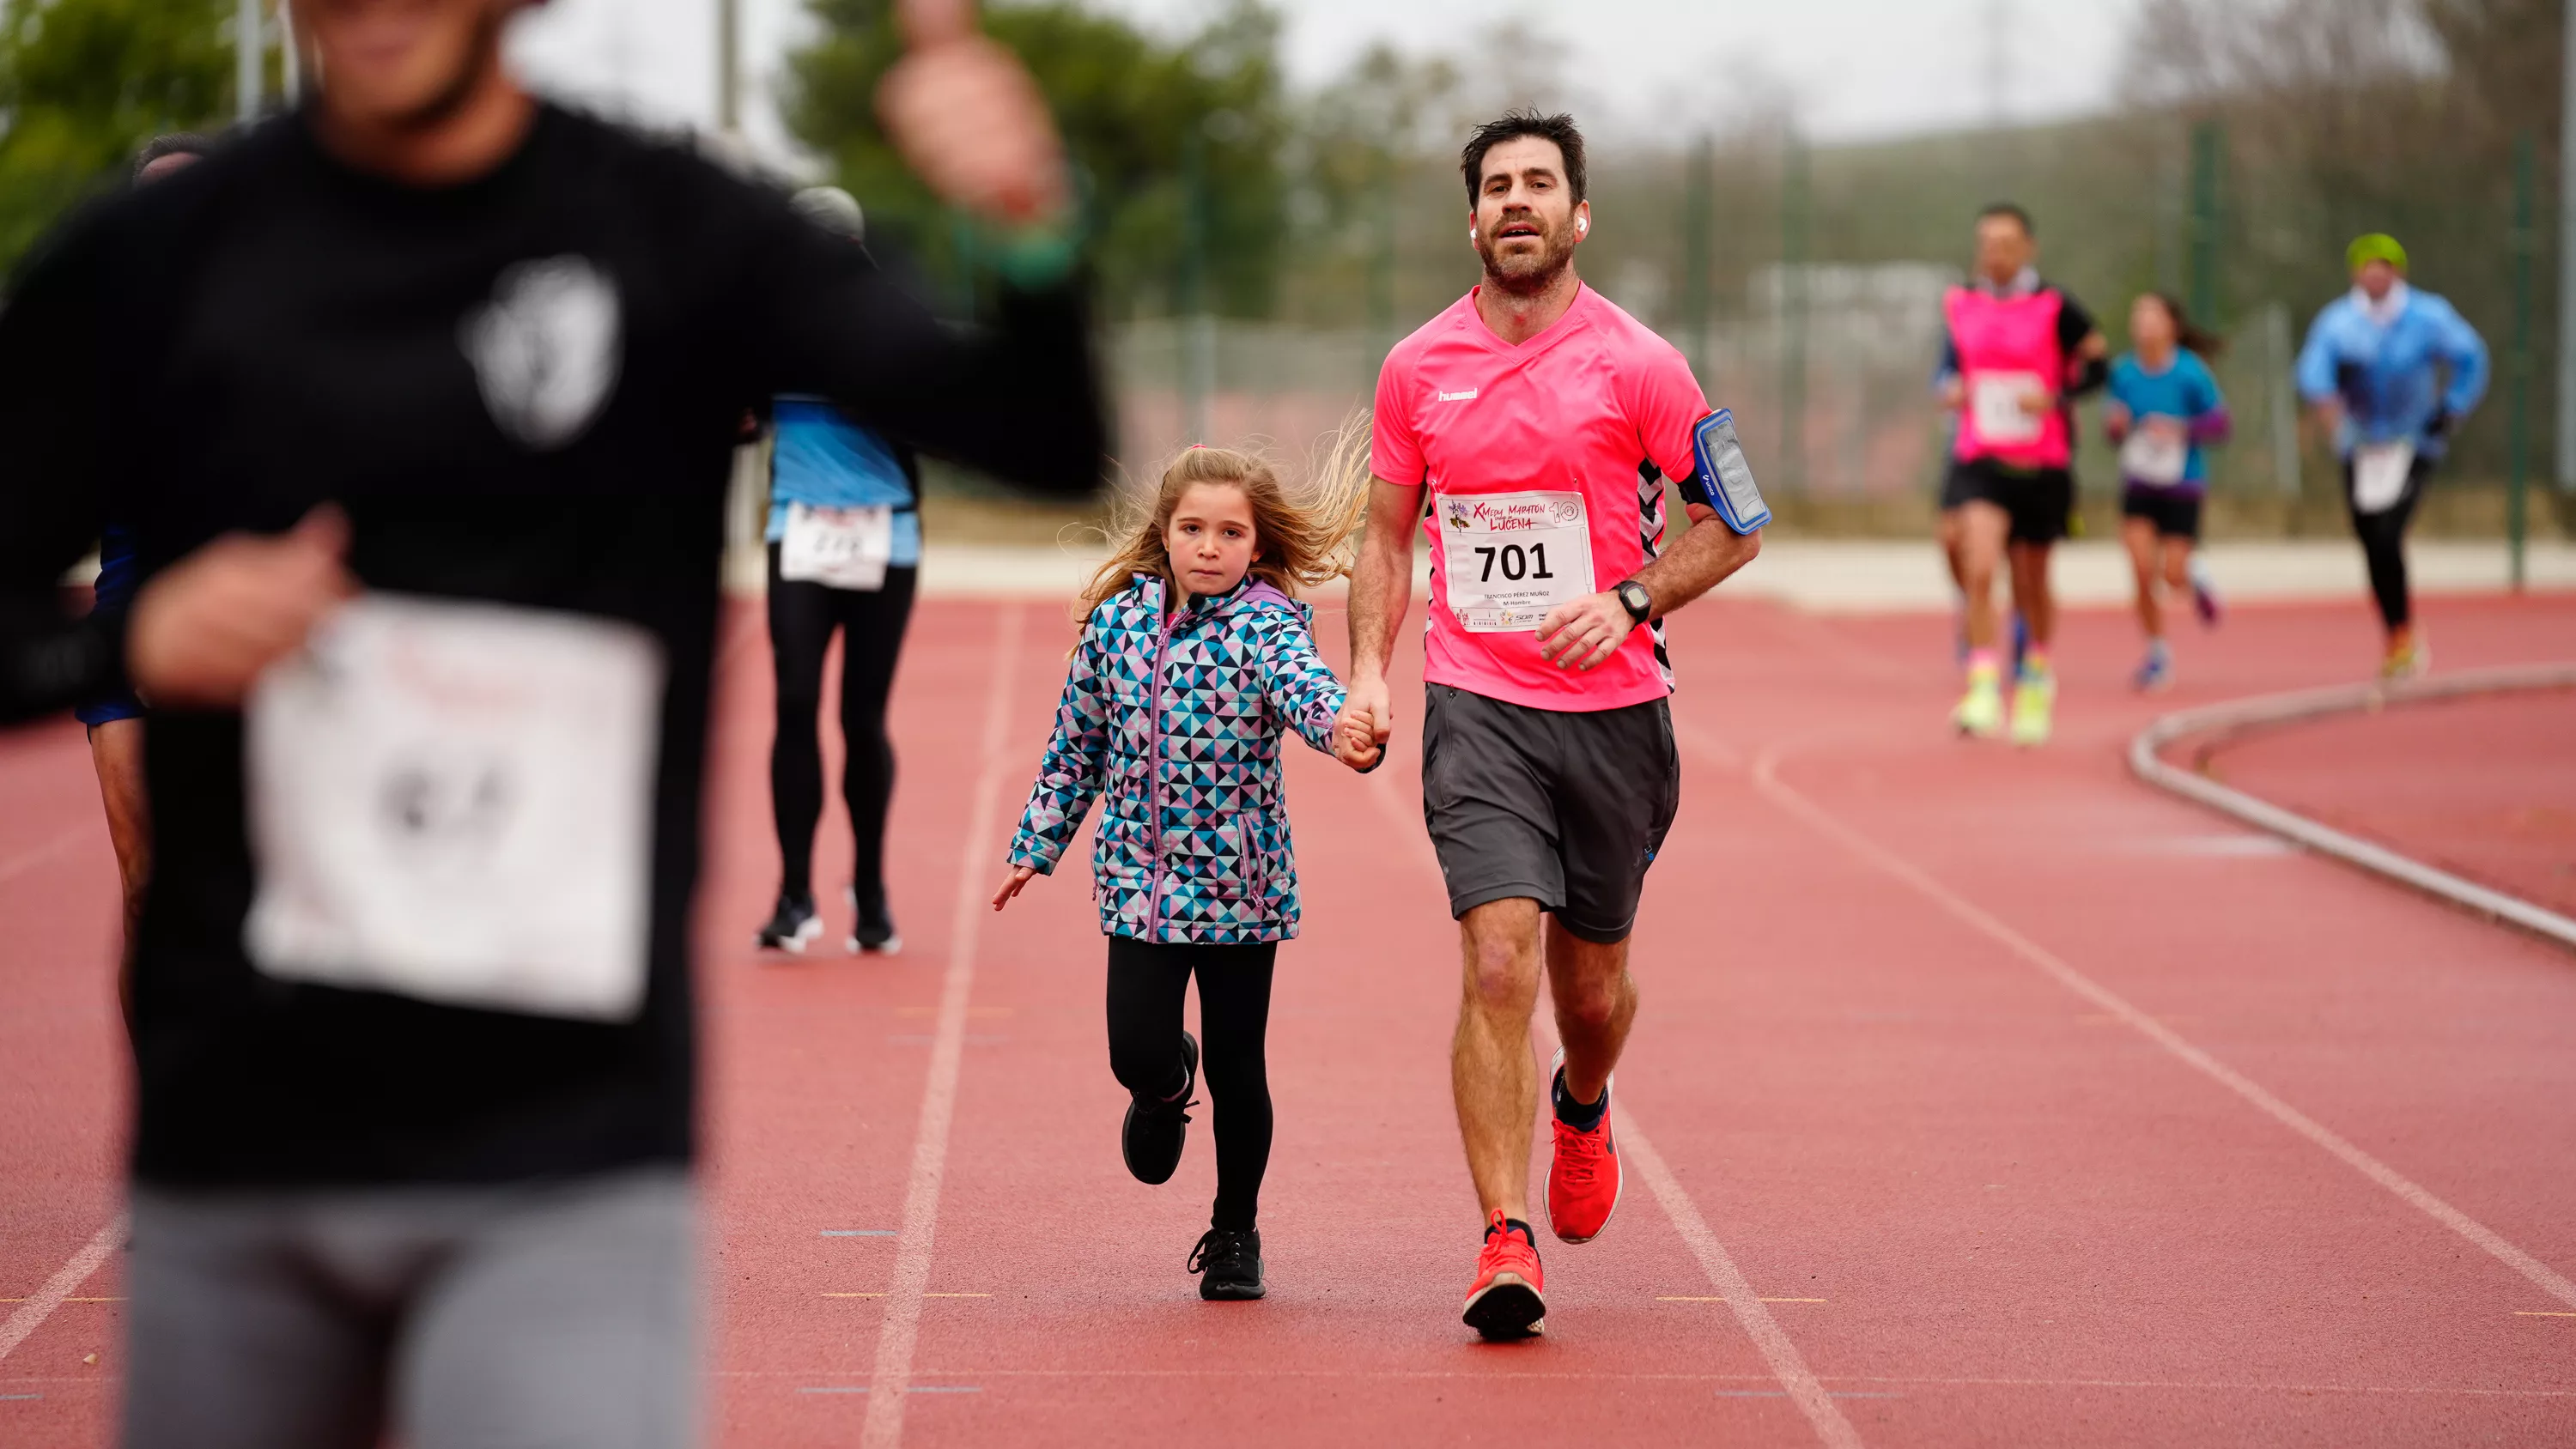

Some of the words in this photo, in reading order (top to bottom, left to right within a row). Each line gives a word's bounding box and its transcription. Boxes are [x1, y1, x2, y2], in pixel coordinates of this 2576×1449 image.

[1438, 387, 1478, 402] hummel
[1508, 504, 1546, 515] MARATÓN
[1490, 518, 1539, 531] LUCENA
[1474, 543, 1553, 582] 701
